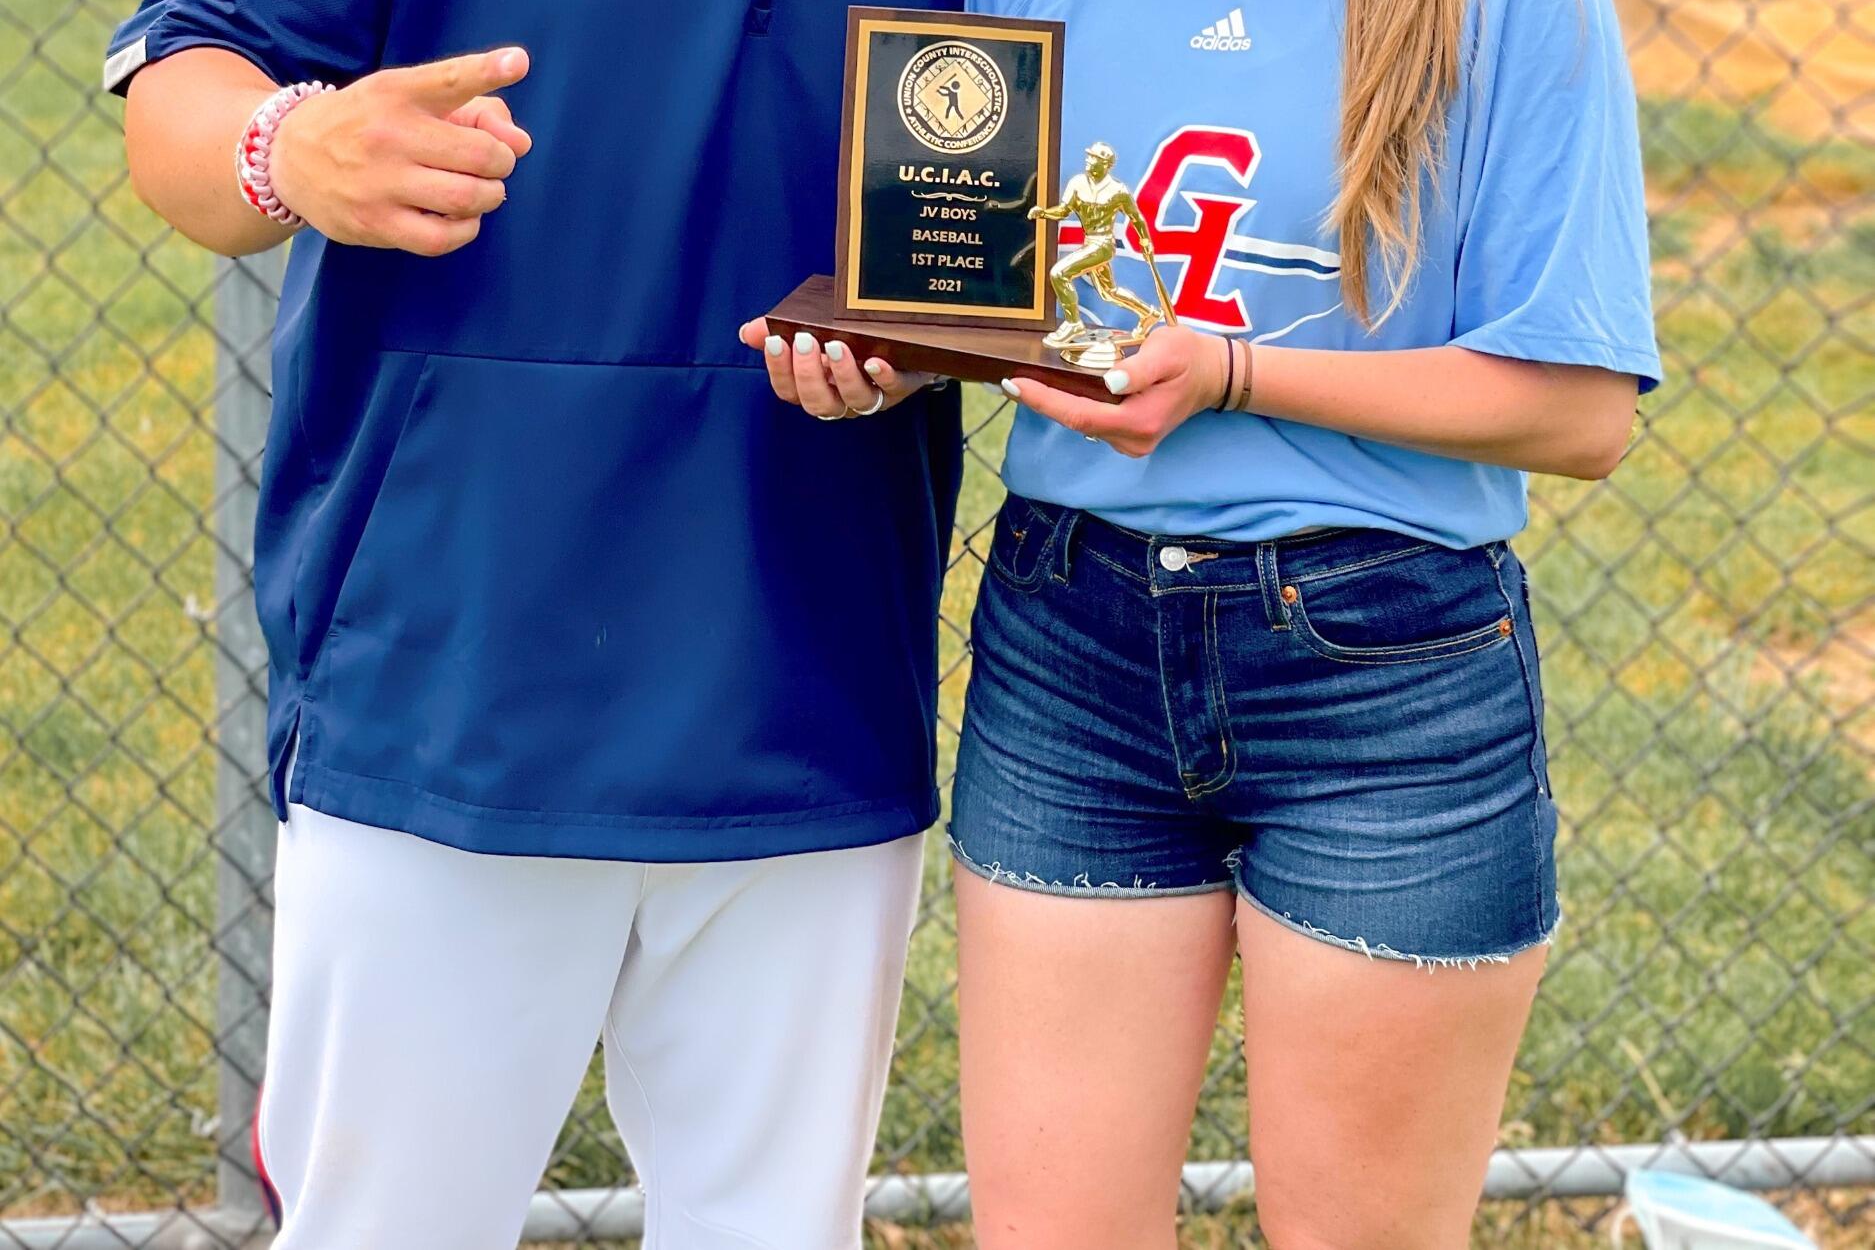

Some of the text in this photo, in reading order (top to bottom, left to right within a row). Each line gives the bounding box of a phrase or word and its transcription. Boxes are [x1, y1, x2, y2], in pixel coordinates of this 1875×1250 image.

[1190, 35, 1252, 51] adidas
[903, 47, 1002, 113] UNION COUNTY INTERSCHOLASTIC
[908, 115, 996, 149] ATHLETIC CONFERENCE
[899, 165, 1000, 187] U.C.I.A.C.
[920, 206, 977, 221] JV BOYS
[912, 229, 983, 245] BASEBALL
[911, 253, 984, 269] 1ST PLACE
[928, 278, 962, 292] 2021
